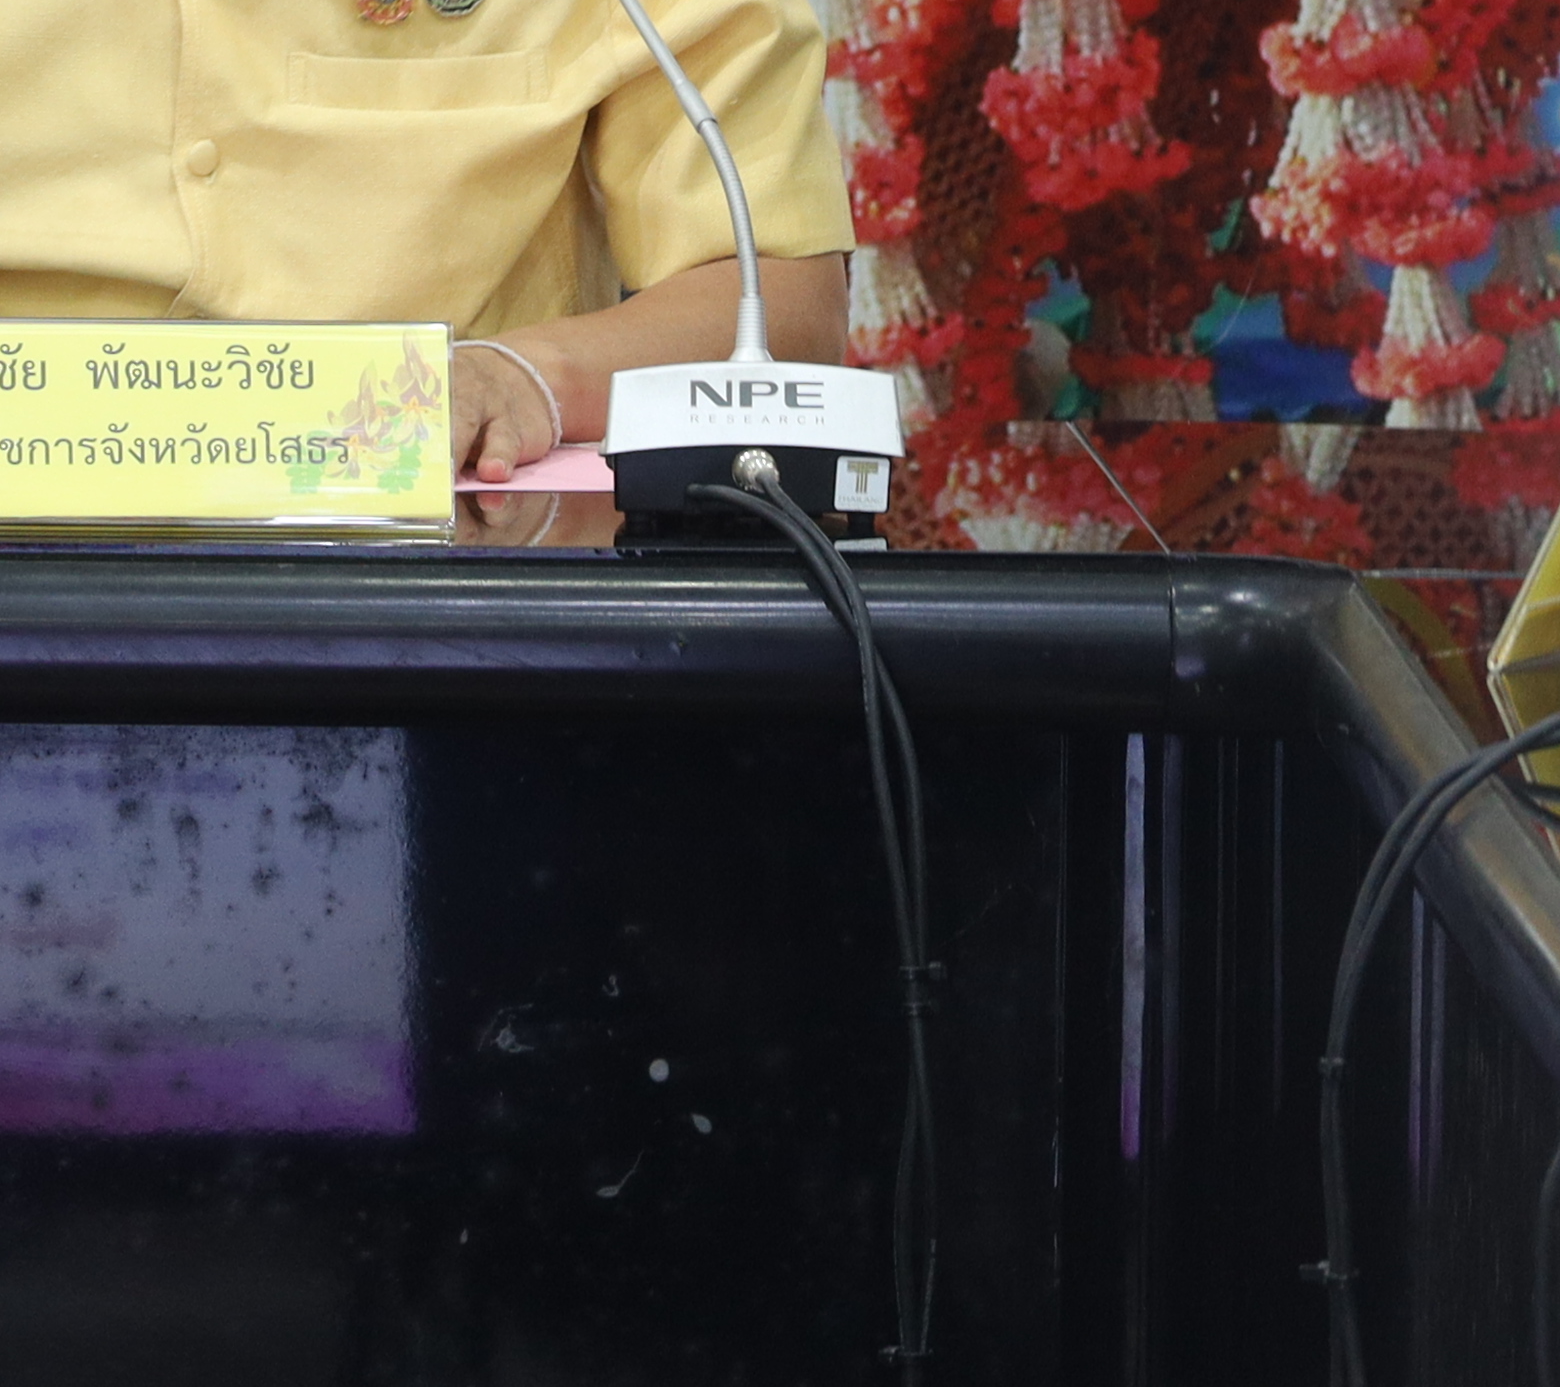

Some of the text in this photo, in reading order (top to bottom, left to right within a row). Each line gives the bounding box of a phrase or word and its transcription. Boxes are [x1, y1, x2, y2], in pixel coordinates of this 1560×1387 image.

[84, 341, 316, 391] พัฒนะวิชัย
[689, 379, 826, 410] NPE
[689, 413, 826, 426] RESEARCH
